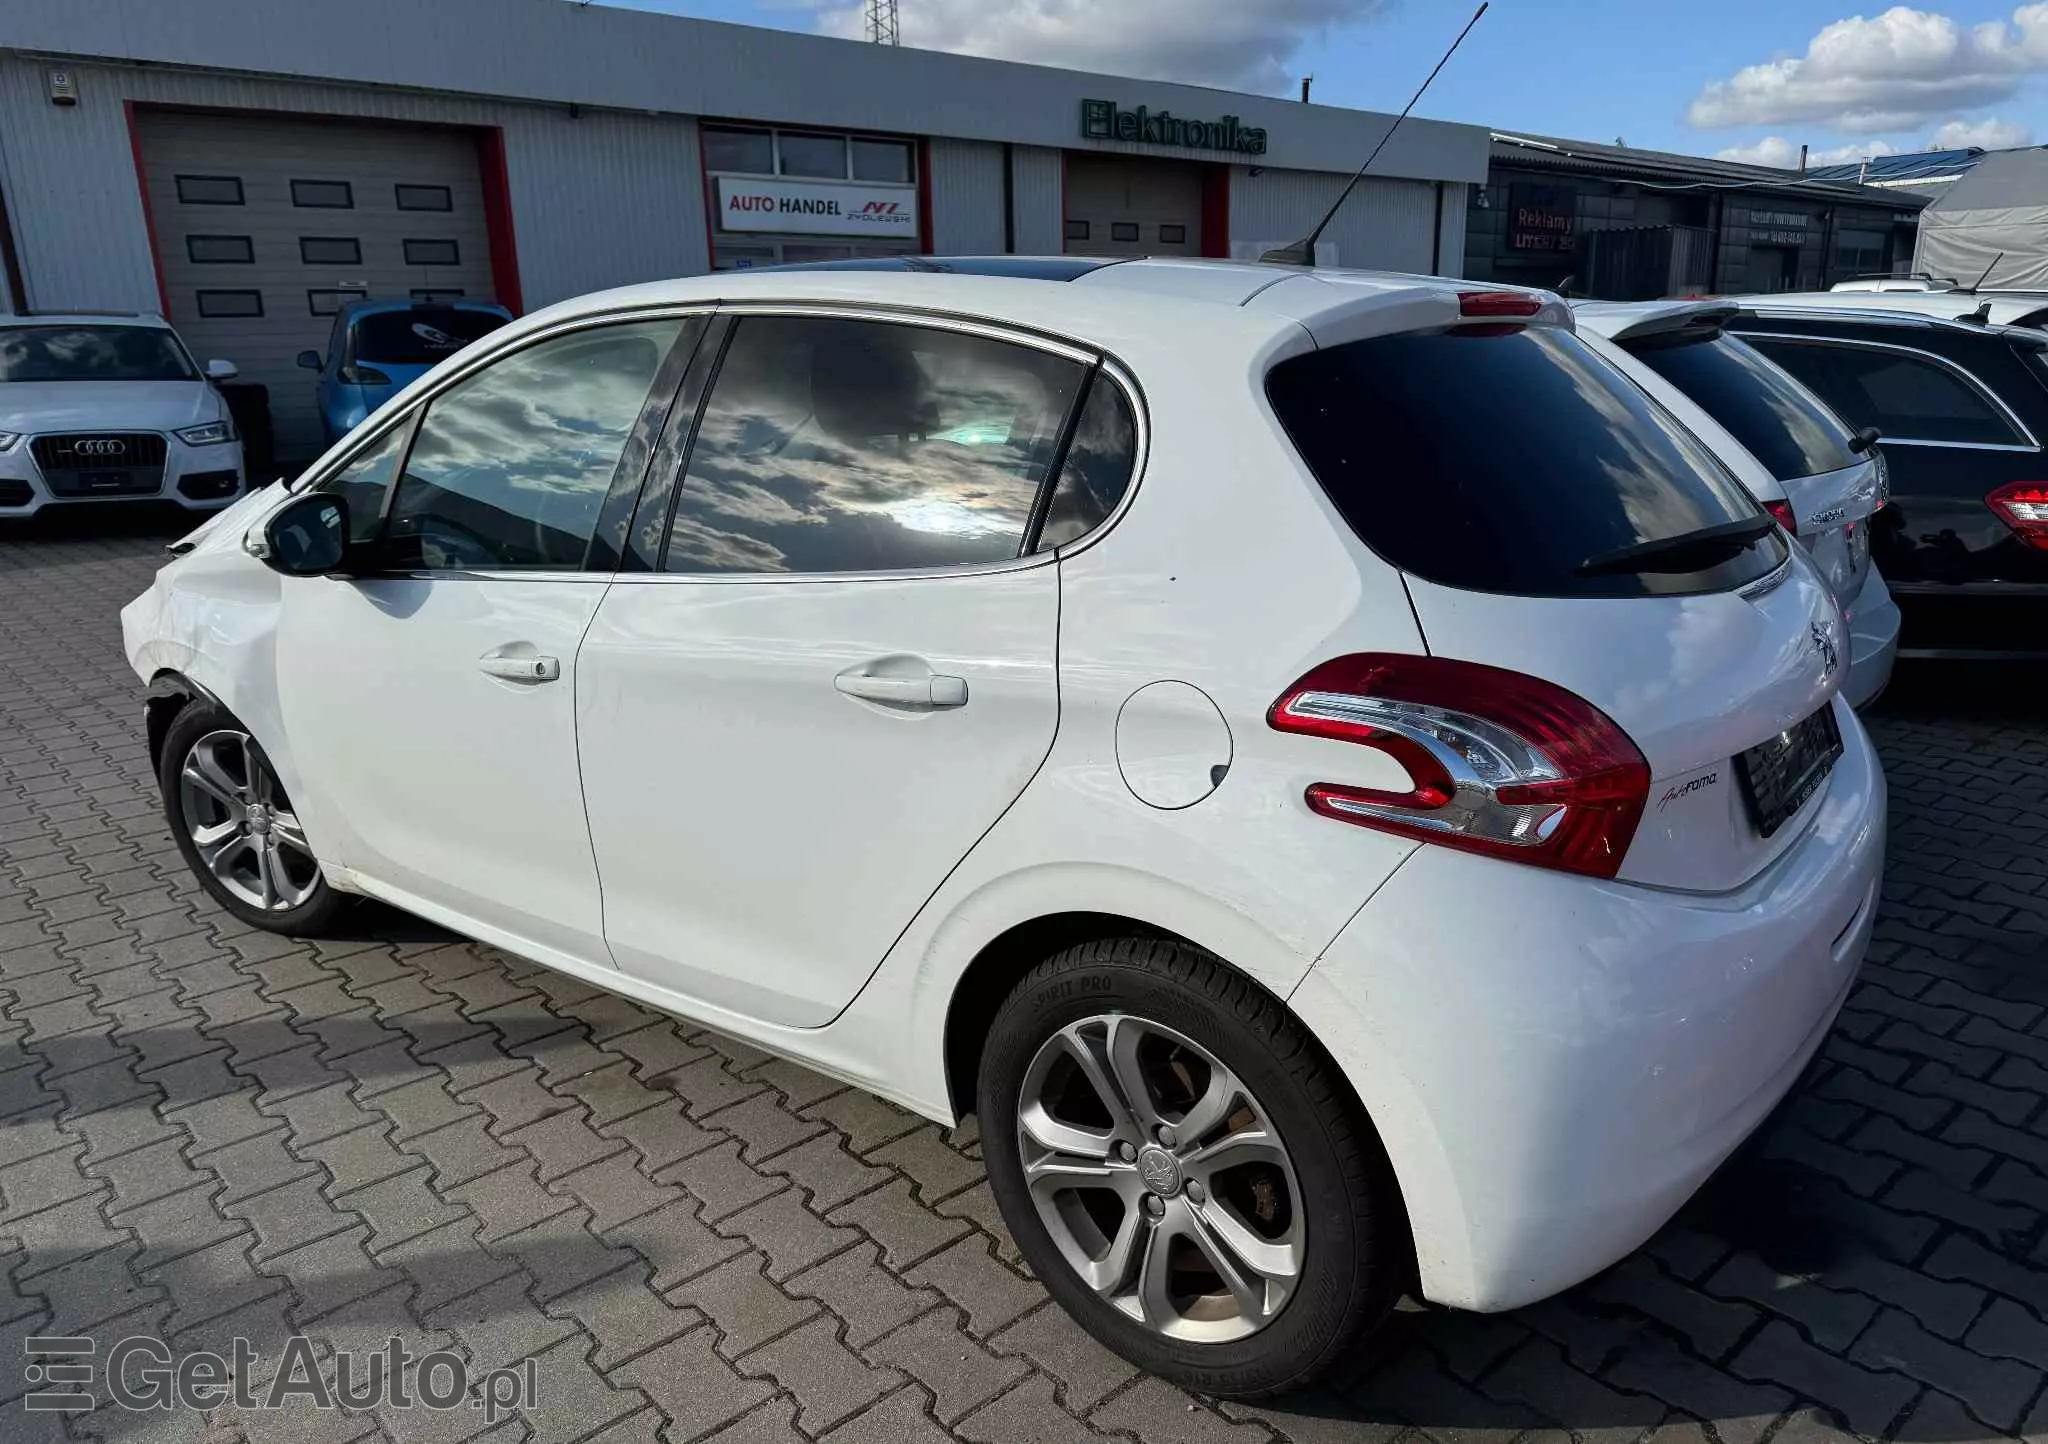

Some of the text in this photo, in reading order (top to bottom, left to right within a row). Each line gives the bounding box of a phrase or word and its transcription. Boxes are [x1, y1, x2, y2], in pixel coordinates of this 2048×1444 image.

[1081, 98, 1268, 154] Elektronika
[729, 195, 842, 216] AUTO HANDEL
[1518, 207, 1573, 234] Reklamy
[1080, 975, 1112, 992] PRO
